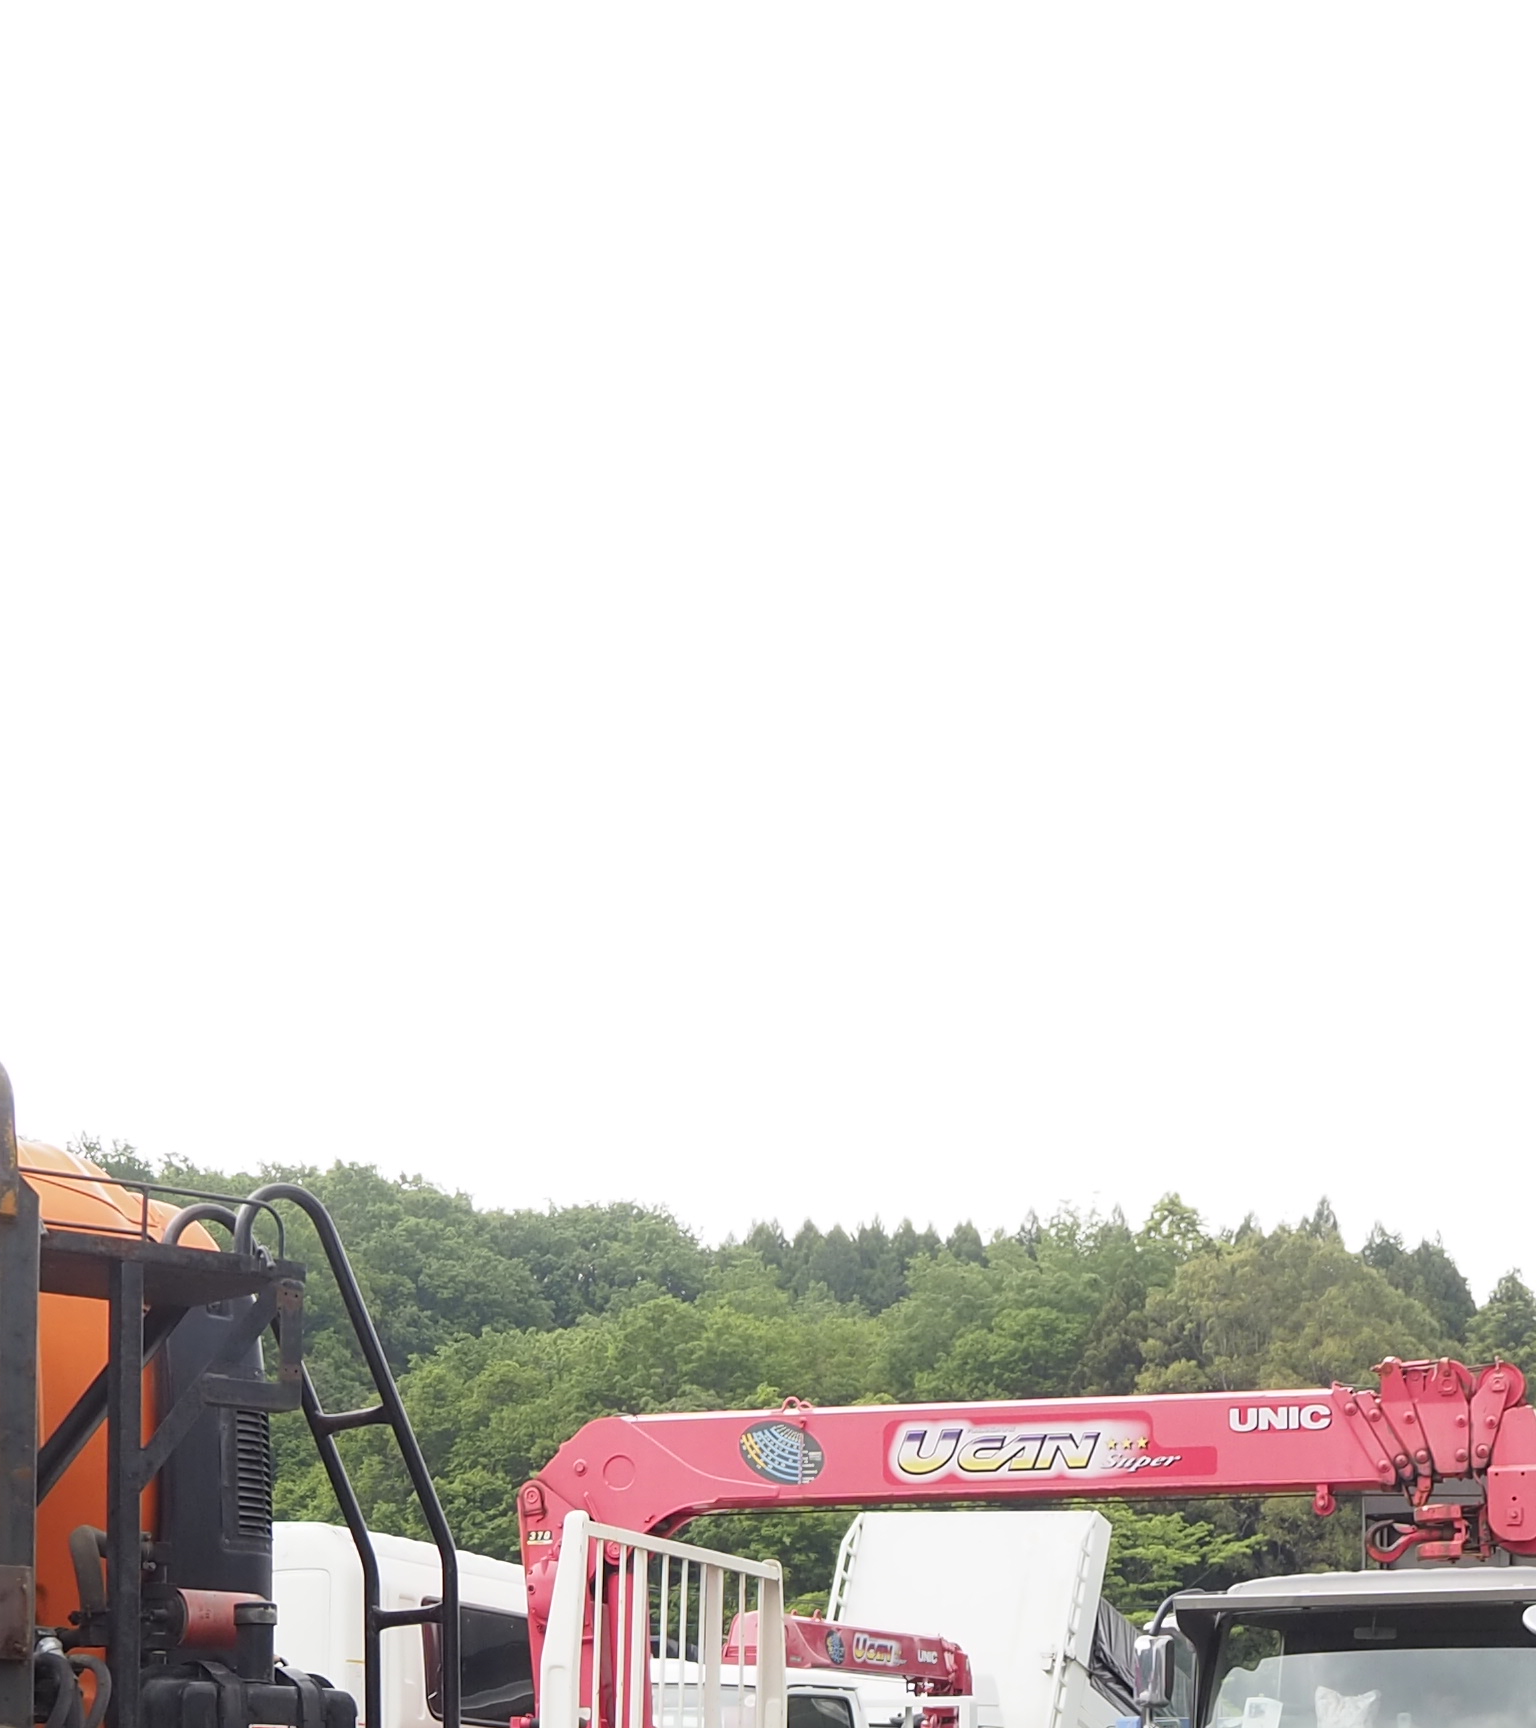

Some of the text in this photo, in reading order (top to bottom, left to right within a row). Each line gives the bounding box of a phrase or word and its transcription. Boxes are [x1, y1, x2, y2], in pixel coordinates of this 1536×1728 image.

[1228, 1403, 1333, 1433] UNIC
[896, 1427, 1183, 1475] UCAN Super
[917, 1648, 939, 1665] UNIC
